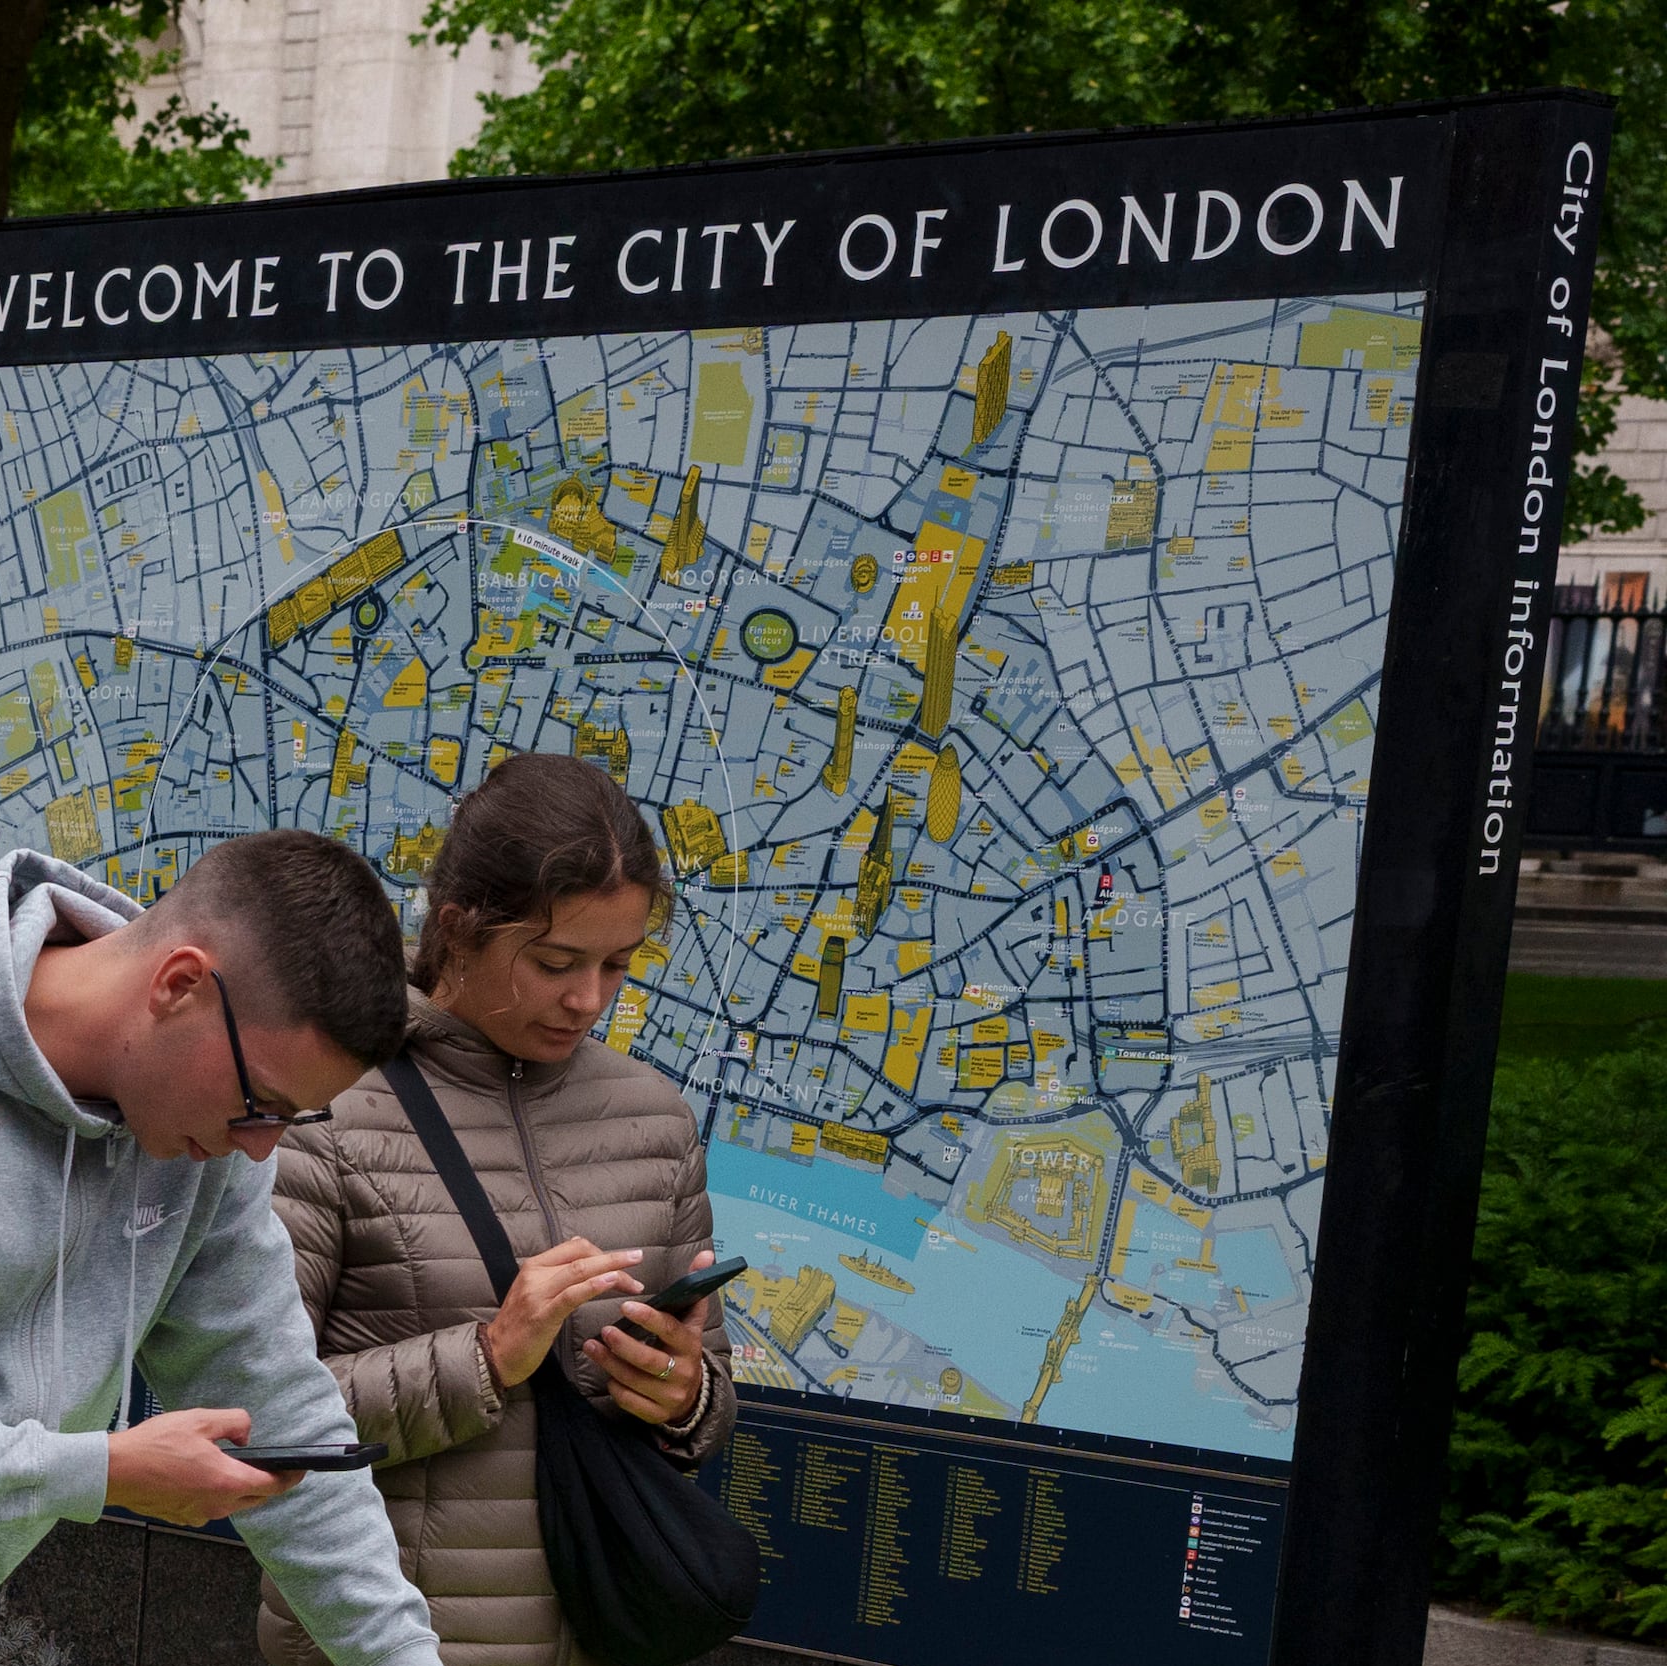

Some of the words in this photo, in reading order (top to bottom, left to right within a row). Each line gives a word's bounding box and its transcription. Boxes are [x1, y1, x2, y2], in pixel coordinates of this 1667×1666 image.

[1554, 142, 1593, 255] City
[319, 249, 404, 312] TO
[446, 236, 577, 305] THE
[618, 219, 796, 294] CITY
[840, 210, 945, 281] OF
[993, 176, 1404, 273] LONDON
[1547, 278, 1573, 337] of
[487, 389, 518, 399] Golden
[520, 389, 540, 398] Lane
[499, 399, 526, 408] Estate
[1519, 358, 1569, 556] London
[299, 491, 427, 510] FARRINGDON
[1063, 514, 1099, 523] Market
[425, 523, 457, 532] Barbican
[523, 531, 532, 543] 10
[533, 538, 561, 557] minute
[561, 553, 580, 569] walk
[802, 558, 850, 568] Broadgate
[892, 565, 932, 574] Liverpool
[478, 572, 580, 588] BARBICAN
[665, 569, 788, 586] MOORGATE
[891, 574, 918, 584] Street
[645, 601, 683, 611] Moorgate
[749, 625, 788, 636] Finsbury
[798, 626, 929, 644] LIVERPOOL
[753, 636, 783, 646] Circus
[820, 649, 903, 665] STREET
[53, 684, 137, 701] HOLBORN
[1480, 580, 1534, 875] information
[854, 741, 912, 752] Bishopsgate
[1219, 737, 1255, 747] Corner
[293, 751, 308, 761] City
[1233, 802, 1270, 812] Aldgate
[1231, 812, 1252, 822] East
[1087, 824, 1124, 835] Aldgate
[660, 854, 704, 871] ANK
[1098, 889, 1135, 899] Aldgate
[816, 911, 867, 924] Leadenhall
[1081, 908, 1198, 930] ALDGATE
[825, 922, 858, 932] Market
[982, 983, 1028, 993] Fenchurch
[982, 993, 1010, 1002] Street
[705, 1048, 748, 1059] Monument
[1117, 1047, 1147, 1059] Tower
[1148, 1048, 1189, 1063] Gateway
[692, 1076, 824, 1101] MONUMENT
[1047, 1093, 1075, 1105] Tower
[1077, 1095, 1094, 1105] Hill
[1006, 1146, 1091, 1171] TOWER
[749, 1184, 799, 1211] RIVER
[807, 1202, 878, 1237] THAMES
[1232, 1323, 1263, 1335] South
[1266, 1327, 1294, 1341] Quay
[730, 1358, 763, 1369] London
